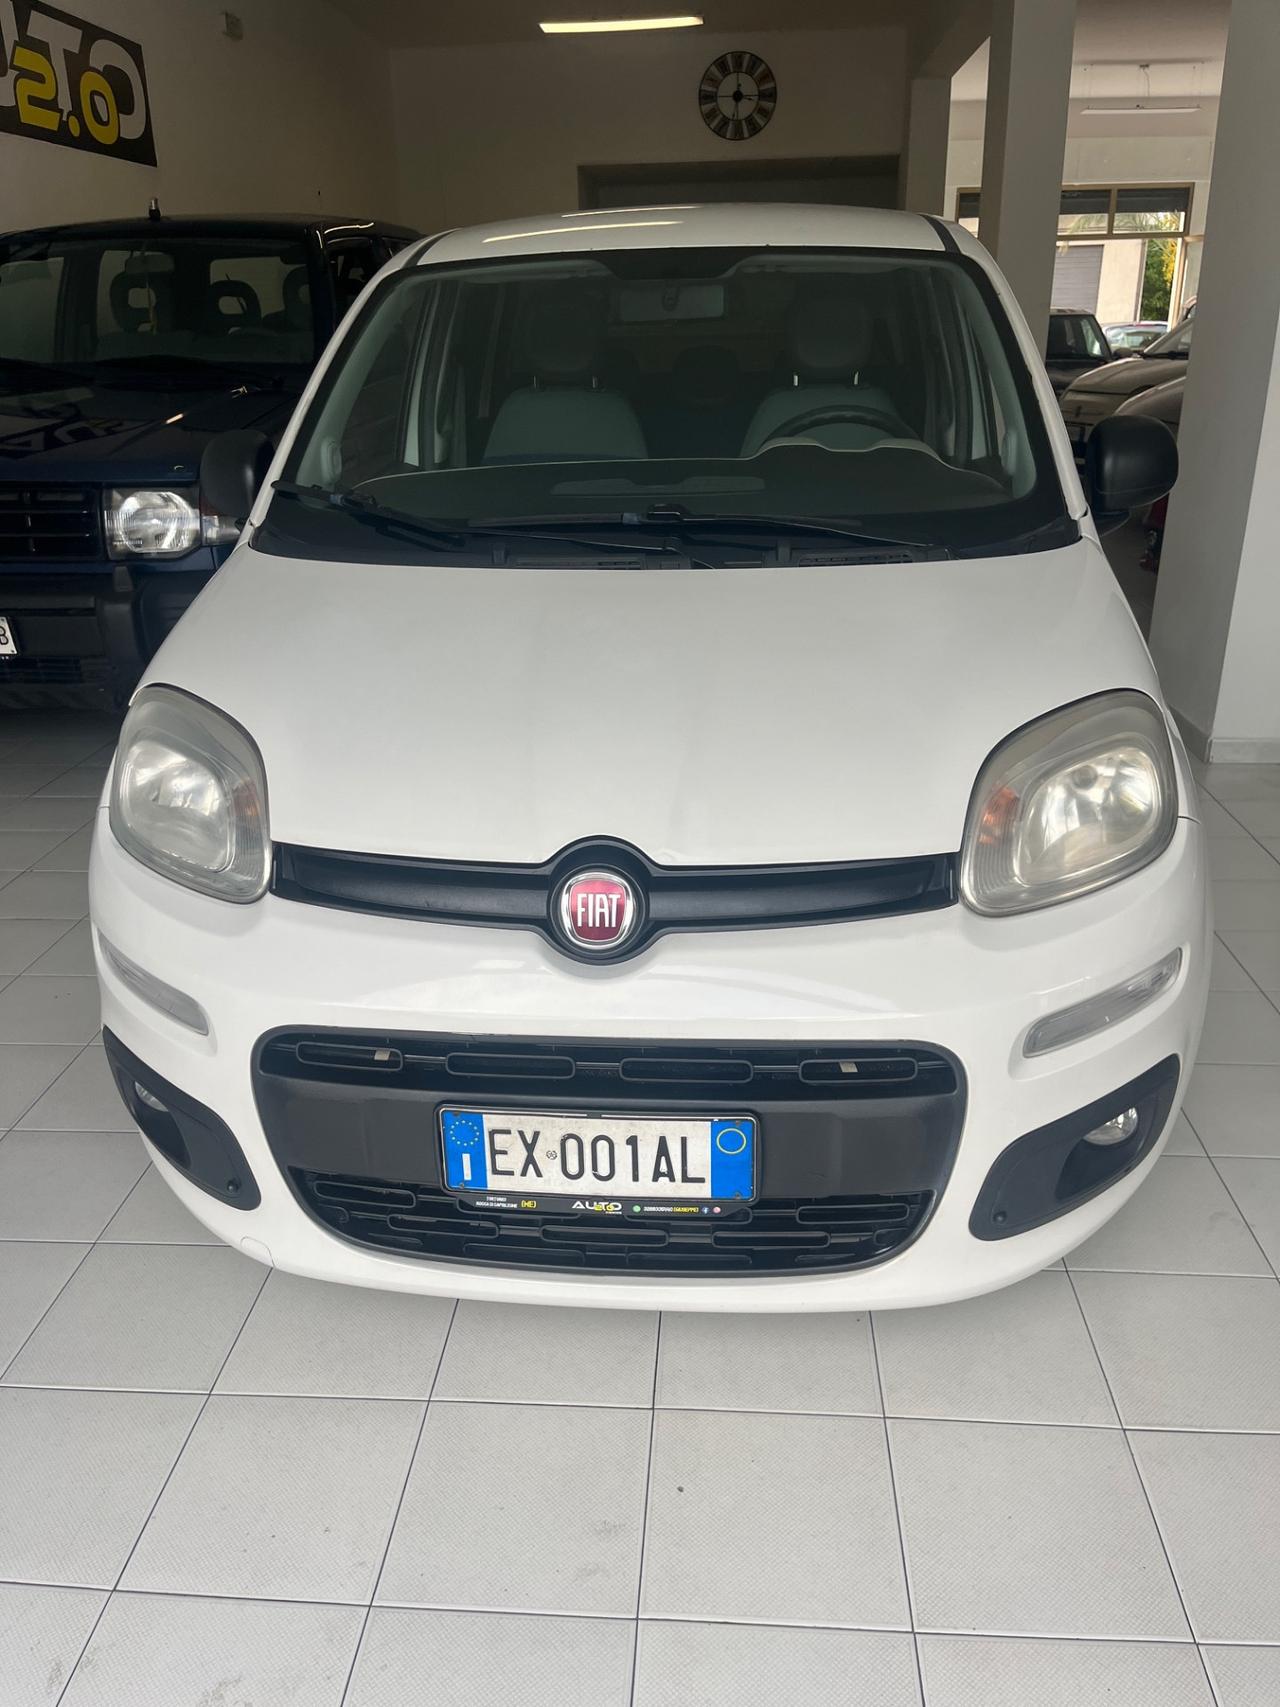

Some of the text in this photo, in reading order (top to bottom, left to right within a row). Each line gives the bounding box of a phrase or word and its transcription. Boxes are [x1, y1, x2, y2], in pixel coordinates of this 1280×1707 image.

[13, 46, 119, 145] 2.0
[576, 893, 621, 928] FIAT
[461, 1153, 472, 1181] I
[571, 1200, 622, 1211] AUTO
